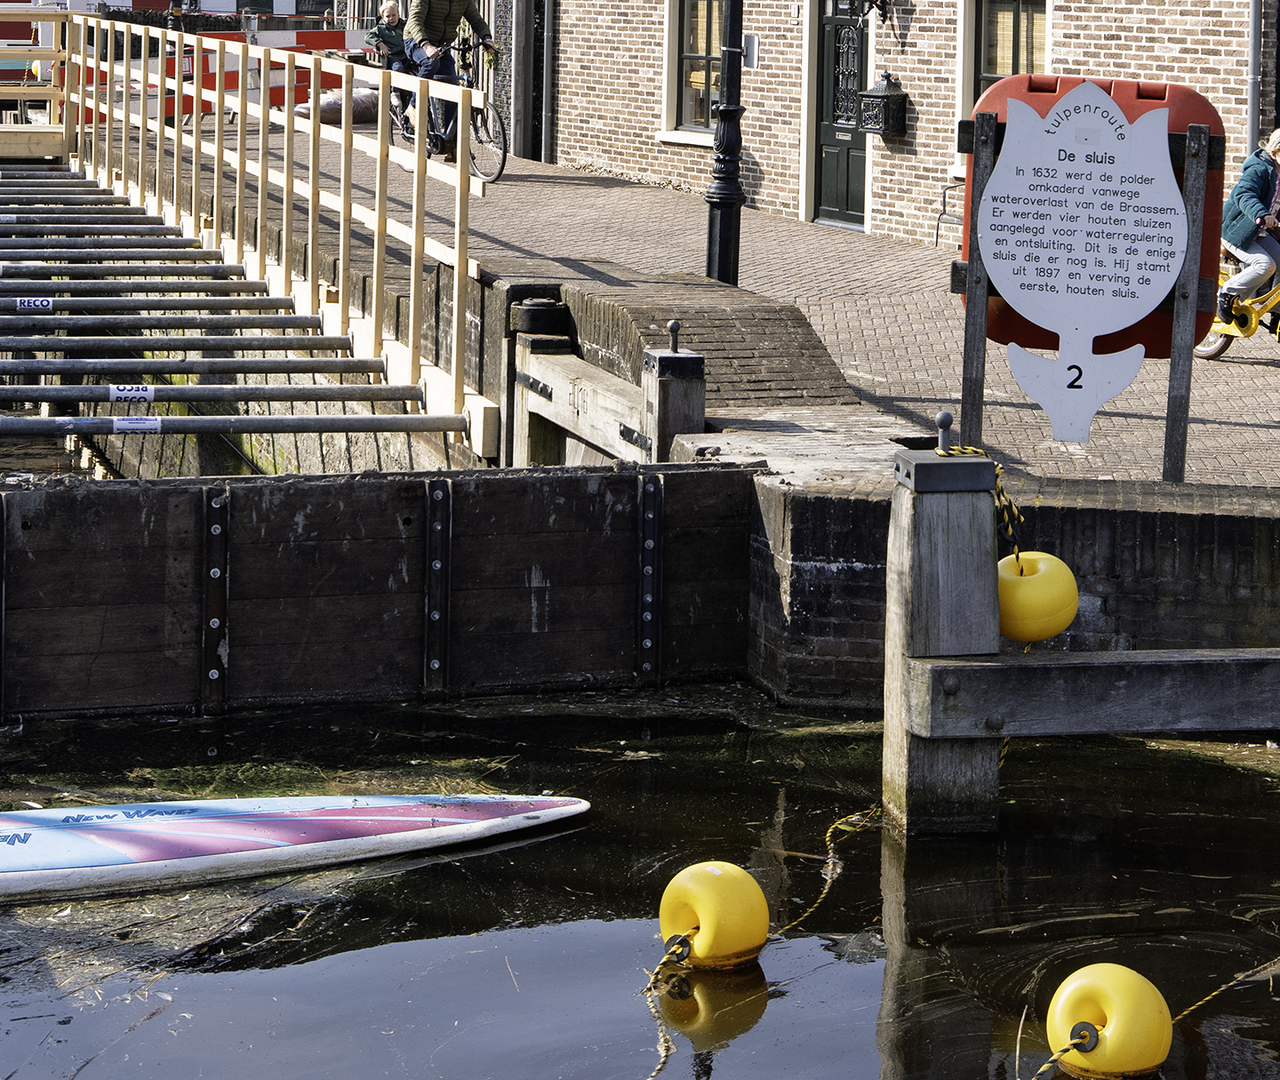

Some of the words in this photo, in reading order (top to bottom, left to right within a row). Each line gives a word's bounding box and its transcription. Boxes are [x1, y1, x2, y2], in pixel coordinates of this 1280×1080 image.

[1044, 102, 1127, 142] tulpenroute
[1058, 149, 1076, 162] De
[1085, 151, 1115, 165] sluis
[1016, 166, 1024, 176] In
[1032, 167, 1057, 178] 1632
[1065, 171, 1092, 181] werd
[1099, 172, 1113, 182] de
[1120, 174, 1155, 185] polder
[1028, 183, 1084, 194] omkaderd
[1092, 188, 1140, 200] vanwege
[991, 194, 1068, 208] wateroverlast
[1100, 201, 1114, 211] de
[1120, 202, 1179, 215] Braassem.
[992, 207, 1004, 217] Er
[1012, 210, 1052, 221] werden
[1059, 212, 1080, 222] vier
[1088, 214, 1126, 226] houten
[1134, 218, 1171, 229] sluizen
[989, 224, 1045, 237] aangelegd
[1052, 228, 1078, 237] voor
[1086, 229, 1173, 246] waterregulering
[995, 238, 1008, 246] en
[1015, 238, 1075, 253] ontsluiting.
[1085, 242, 1100, 253] Dit
[1108, 244, 1117, 254] is
[1125, 246, 1138, 256] de
[1146, 248, 1176, 261] enige
[993, 250, 1017, 261] sluis
[1024, 252, 1040, 263] die
[1048, 256, 1059, 264] er
[1067, 258, 1087, 269] nog
[1095, 257, 1106, 267] is.
[1114, 259, 1129, 272] Hij
[1137, 261, 1170, 272] stamt
[1013, 266, 1026, 276] uit
[1035, 267, 1060, 278] 1897
[1068, 272, 1081, 280] en
[1089, 273, 1130, 286] verving
[1137, 275, 1151, 285] de
[1020, 282, 1059, 294] eerste,
[1066, 284, 1104, 296] houten
[1112, 288, 1139, 299] sluis.
[19, 299, 50, 308] RECO
[1066, 364, 1083, 389] 2
